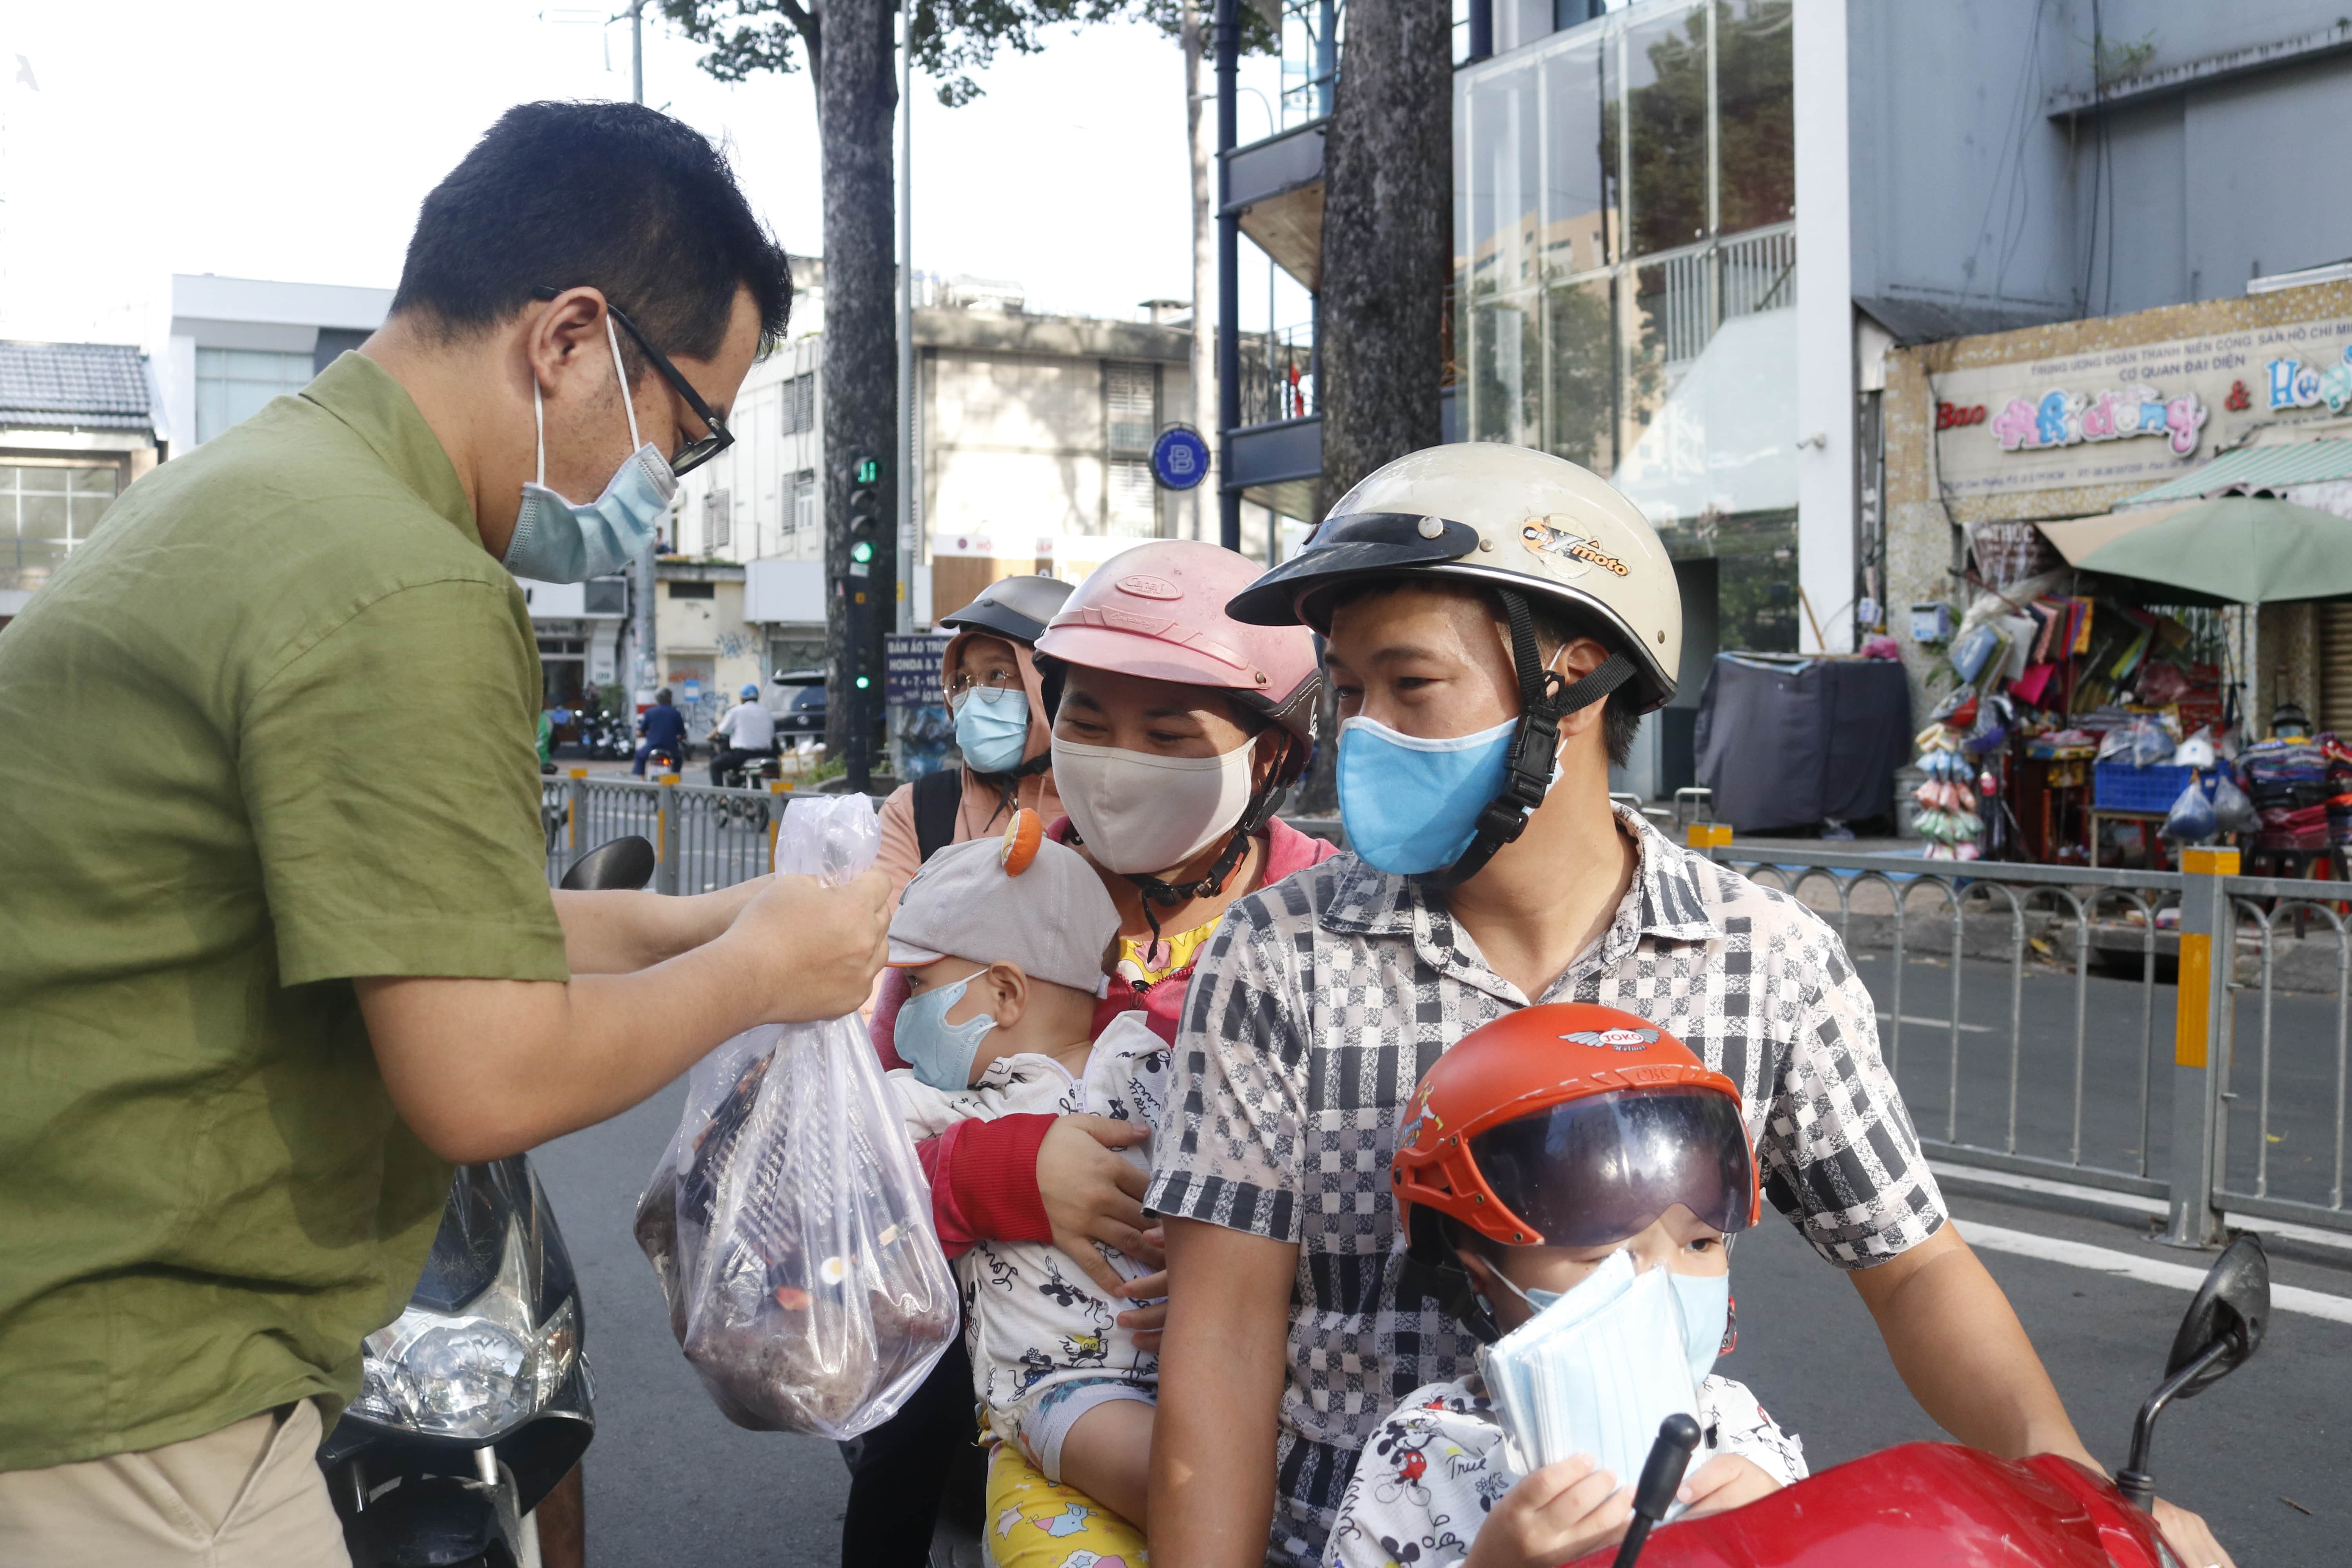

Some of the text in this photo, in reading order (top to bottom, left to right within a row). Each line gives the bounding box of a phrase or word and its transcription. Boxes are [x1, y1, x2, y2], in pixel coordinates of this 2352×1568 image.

[1571, 543, 1628, 577] moto
[889, 659, 923, 671] HONDA
[1602, 1033, 1642, 1042] JOKO
[1446, 1454, 1486, 1480] True
